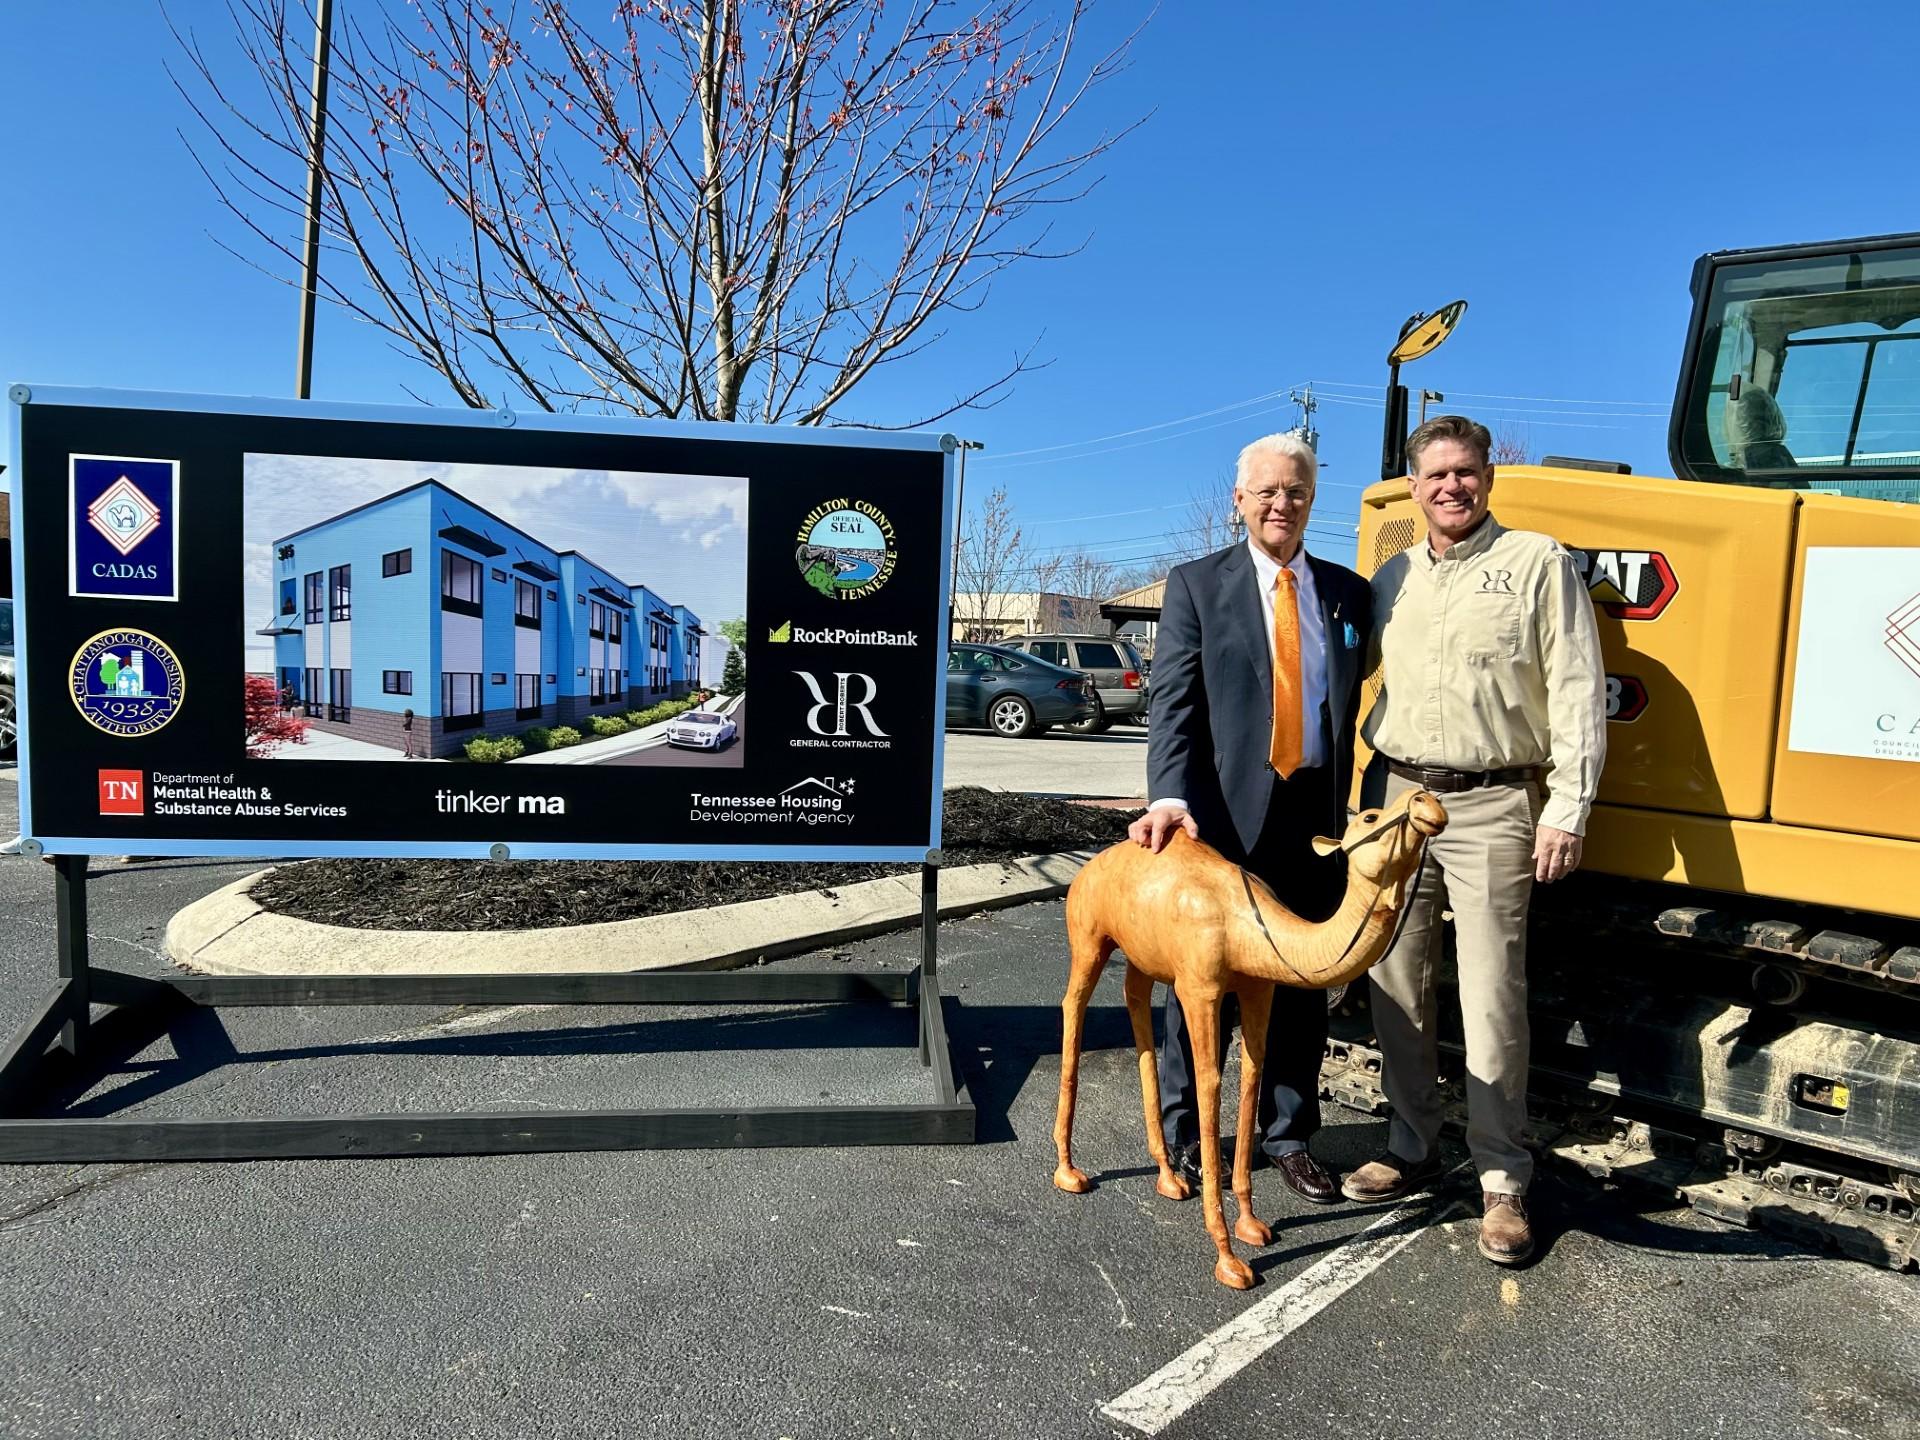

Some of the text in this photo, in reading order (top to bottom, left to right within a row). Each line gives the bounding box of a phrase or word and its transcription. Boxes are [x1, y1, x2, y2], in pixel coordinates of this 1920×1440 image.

[832, 515, 863, 523] OFFICIAL
[831, 522, 864, 534] SEAL
[797, 498, 898, 600] HAMILTON COUNTY TENNESSEE
[92, 563, 158, 580] CADAS
[793, 627, 918, 646] RockPointBank
[74, 632, 181, 734] CHATTANOOGA HOUSING AUTHORITY
[103, 699, 156, 719] 1938
[790, 739, 891, 749] GENERAL CONTRACTOR
[153, 772, 235, 785] Department of
[103, 780, 138, 800] TN
[153, 786, 272, 800] Mental Health &
[154, 802, 347, 817] Substance Abuse Services
[435, 789, 565, 814] tinker ma
[691, 793, 842, 811] Tennessee Housing
[690, 809, 855, 826] Development Agency
